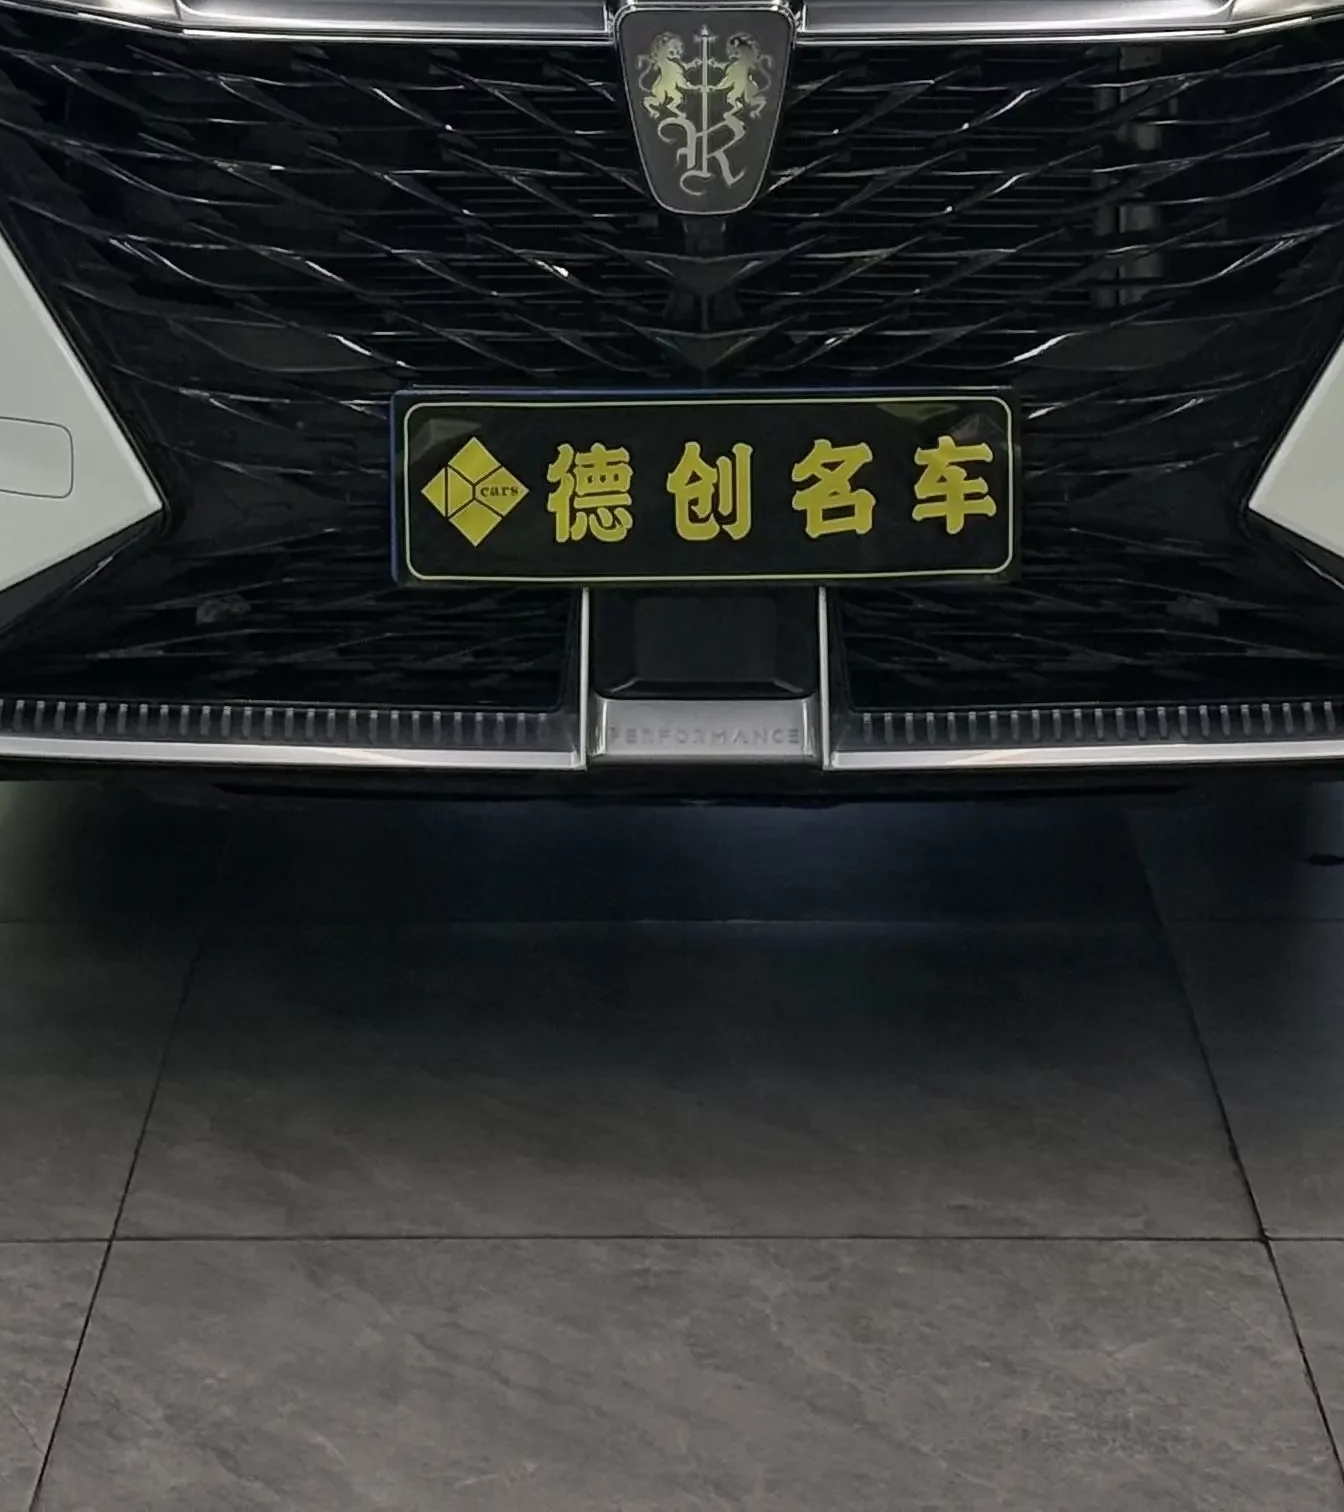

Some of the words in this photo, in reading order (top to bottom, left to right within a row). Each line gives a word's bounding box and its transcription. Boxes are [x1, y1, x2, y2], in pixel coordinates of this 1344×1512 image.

[547, 436, 997, 543] 德创名车
[609, 726, 801, 745] PERFORMANCE
